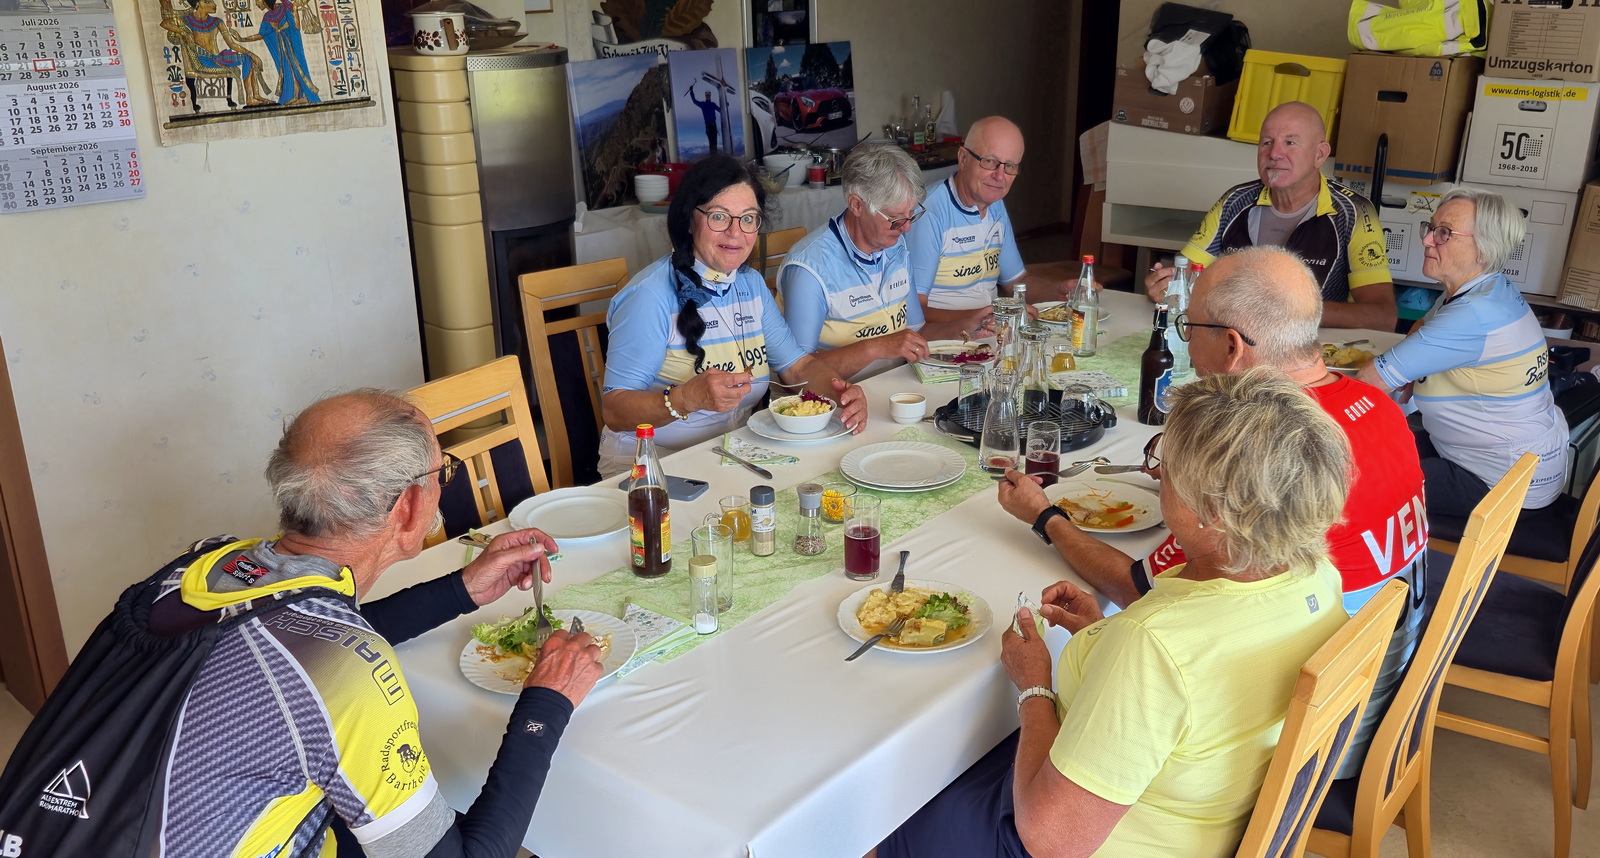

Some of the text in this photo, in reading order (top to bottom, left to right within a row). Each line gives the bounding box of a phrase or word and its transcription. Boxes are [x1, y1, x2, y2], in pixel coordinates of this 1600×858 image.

[1488, 56, 1592, 74] Umzugskarton
[26, 83, 57, 92] August
[31, 145, 76, 156] September
[1346, 164, 1372, 174] IKE
[953, 265, 982, 277] since
[856, 325, 889, 338] since
